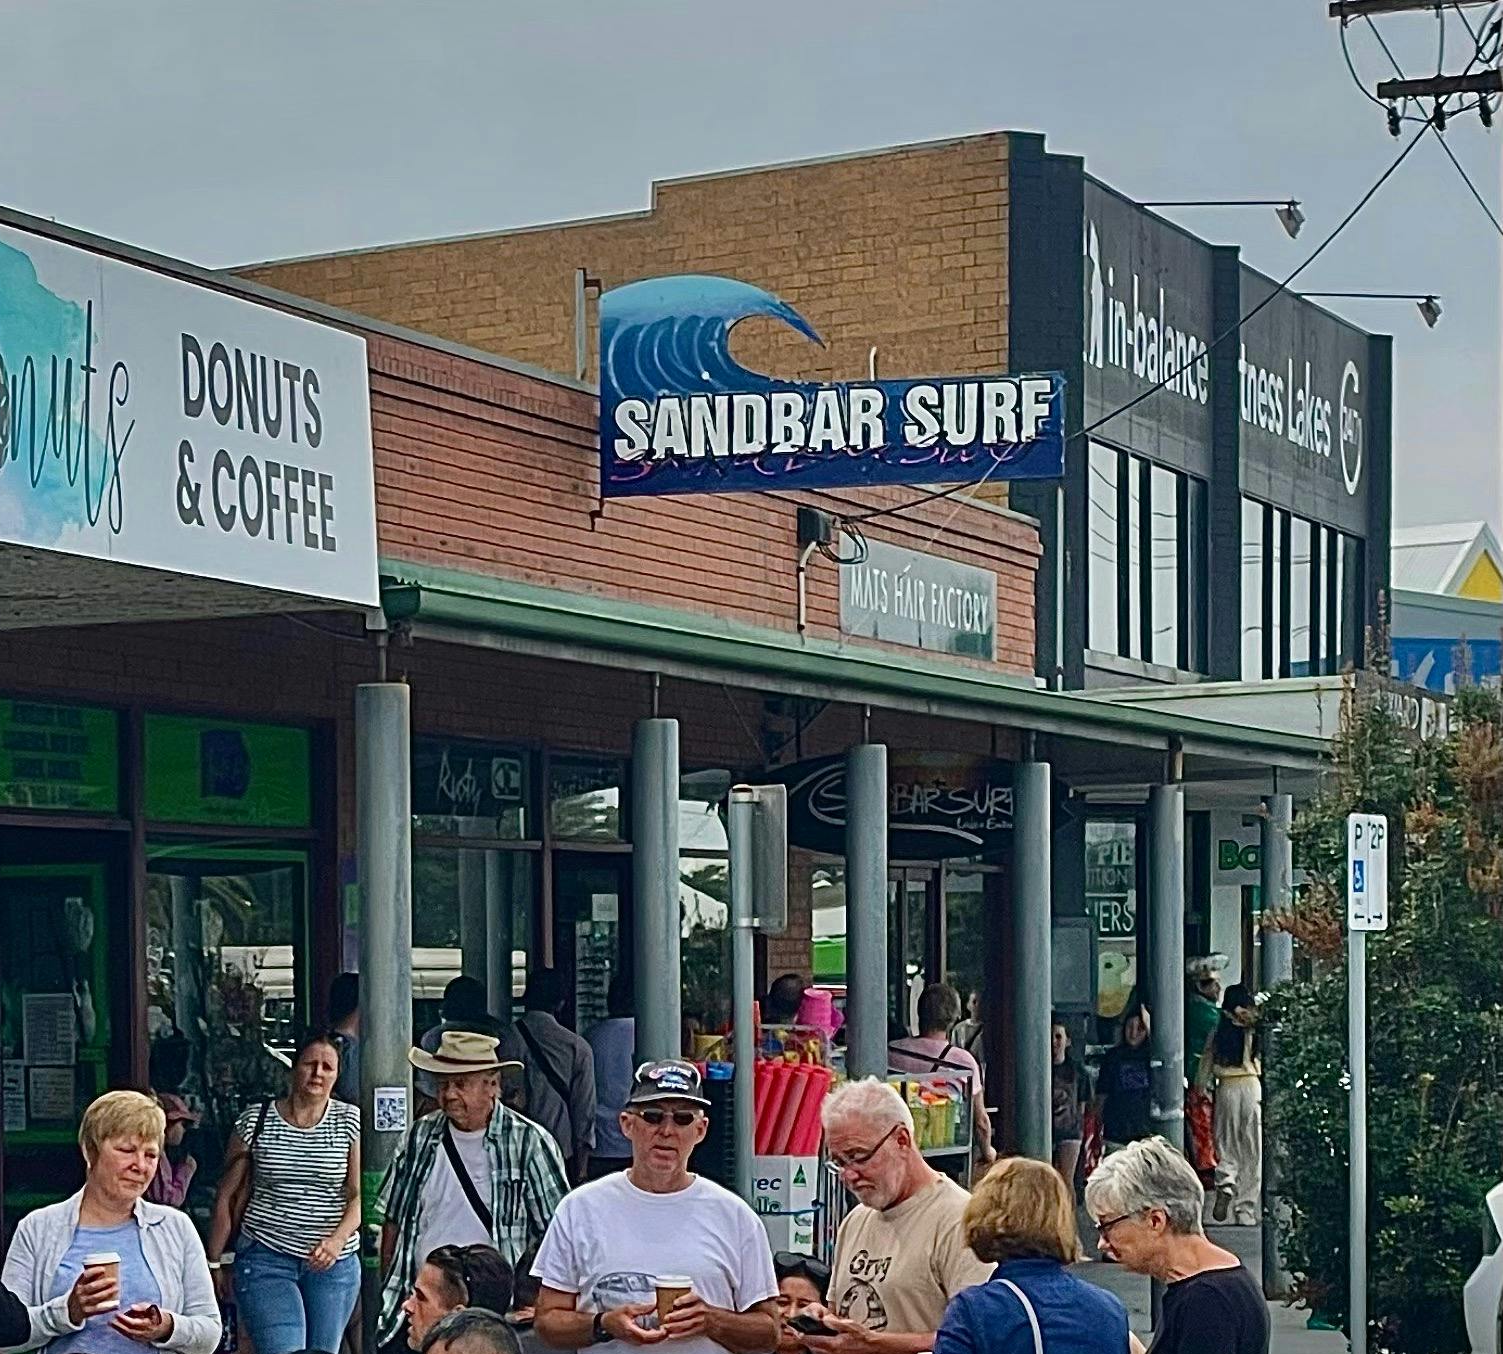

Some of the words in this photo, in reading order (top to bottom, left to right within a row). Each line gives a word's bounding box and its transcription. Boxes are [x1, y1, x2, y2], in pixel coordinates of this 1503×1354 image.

[181, 332, 323, 449] DONUTS
[1108, 266, 1209, 405] in-balance
[1238, 343, 1284, 436] tness
[1288, 358, 1332, 457] Lakes
[613, 386, 887, 463] SANDBAR
[903, 379, 1052, 449] SURF
[175, 440, 206, 527] &
[211, 457, 337, 552] COFFEE
[851, 565, 888, 613] MATS
[894, 573, 926, 622] HAIR
[931, 583, 989, 635] FACTORY
[1354, 823, 1363, 850] P
[1371, 823, 1384, 849] 2P
